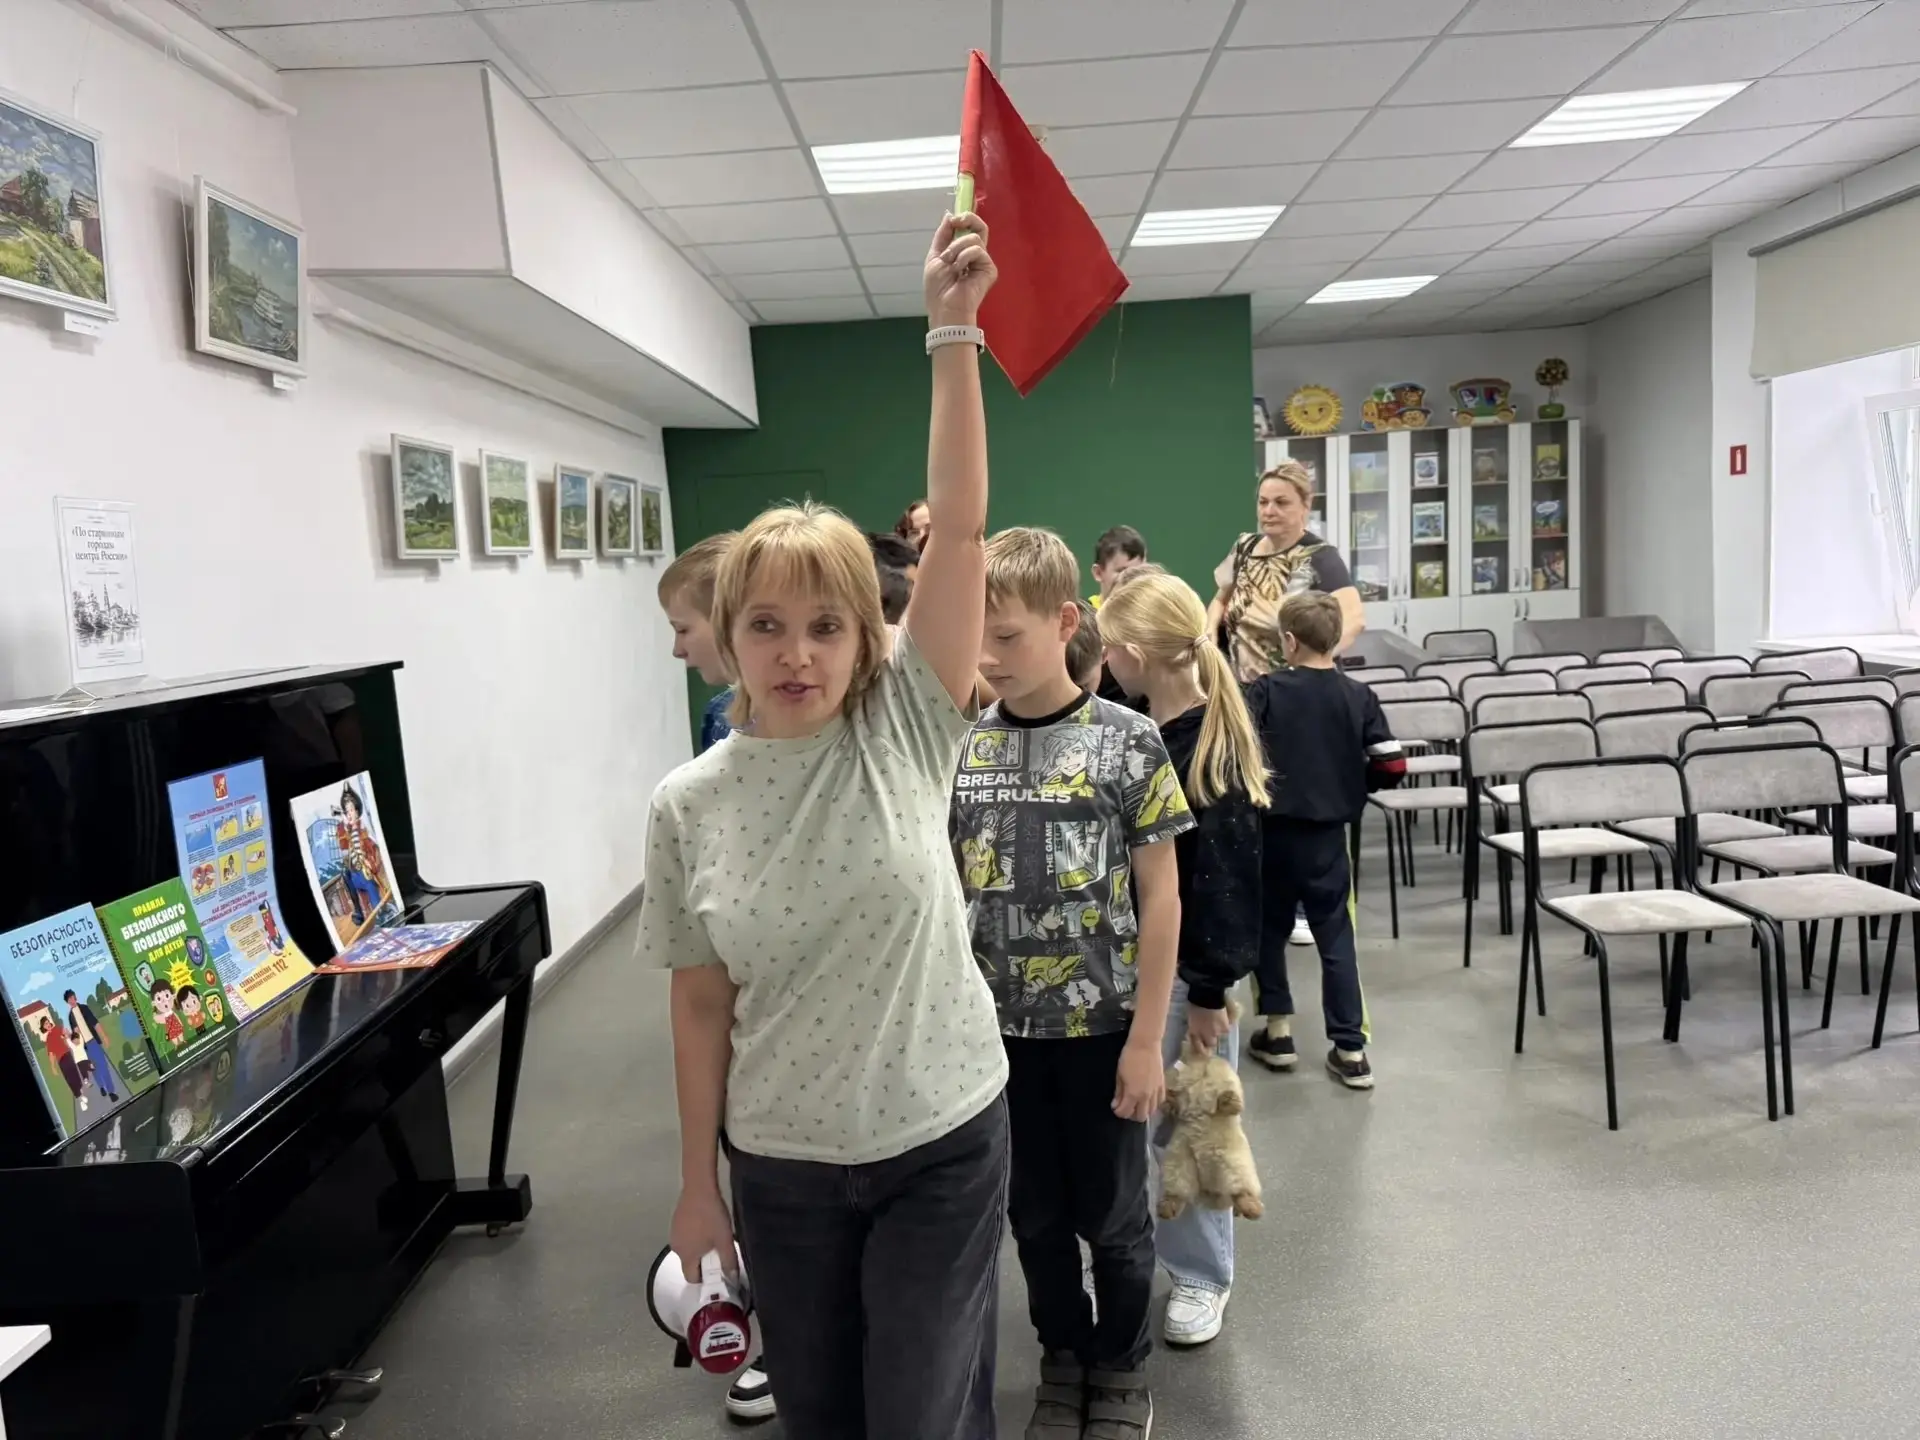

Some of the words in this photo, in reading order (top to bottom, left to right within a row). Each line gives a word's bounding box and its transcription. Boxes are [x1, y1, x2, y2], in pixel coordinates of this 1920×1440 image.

[956, 772, 1023, 787] BREAK
[956, 789, 994, 804] THE
[997, 788, 1072, 803] RULES
[1045, 821, 1053, 852] GAME
[1055, 823, 1062, 838] UP
[1055, 840, 1063, 852] IS
[1046, 853, 1054, 876] THE
[132, 896, 166, 917] ПРАВИЛА
[120, 902, 186, 941] БЕЗОПАСНОГО
[10, 916, 94, 959] БЕЗОПАСНОСТЬ
[50, 948, 60, 963] В
[61, 933, 100, 958] ГОРОДЕ
[132, 919, 188, 954] ПОВЕДЕНИЯ
[148, 947, 164, 963] ДЛЯ
[164, 936, 185, 956] ДЕТЕЙ
[271, 957, 288, 974] 112
